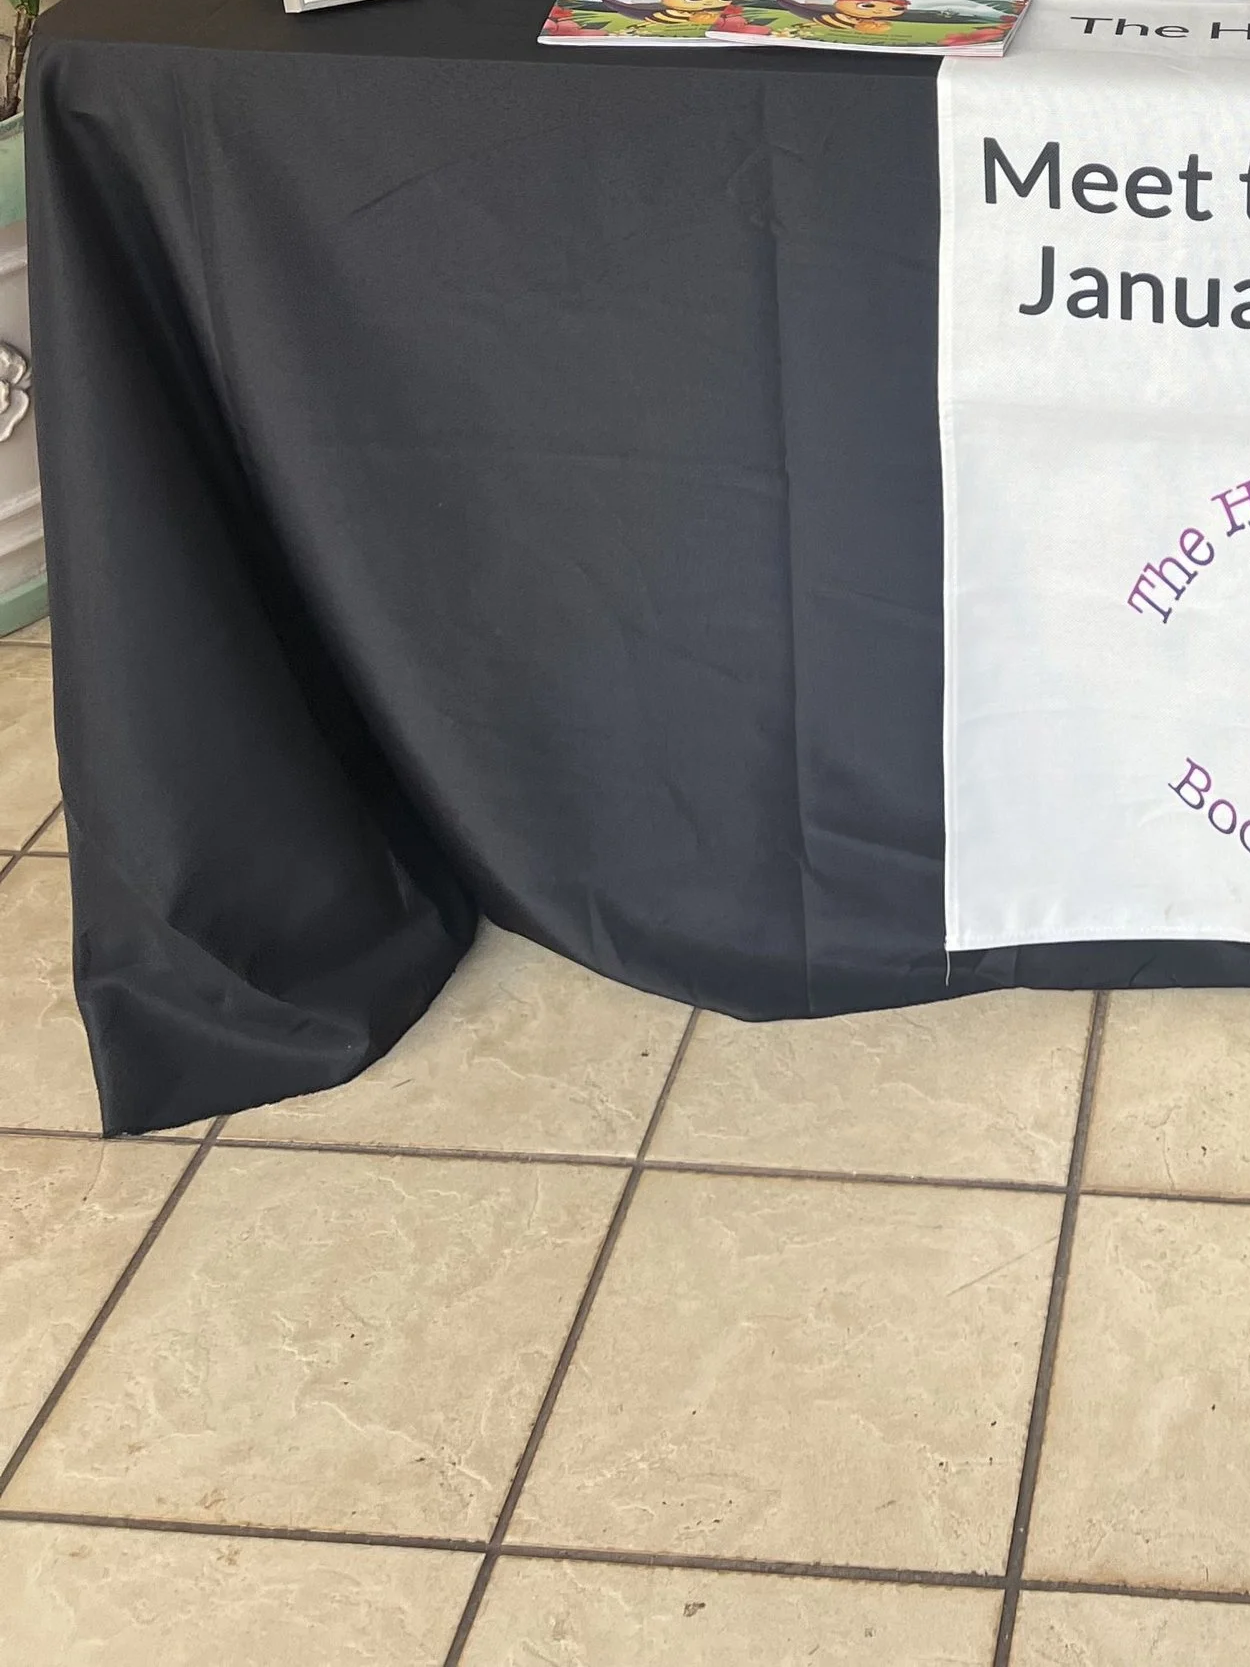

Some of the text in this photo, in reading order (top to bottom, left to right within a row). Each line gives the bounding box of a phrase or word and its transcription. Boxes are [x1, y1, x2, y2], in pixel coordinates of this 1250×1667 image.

[1069, 15, 1190, 41] The
[983, 136, 1215, 222] Meet
[1127, 527, 1215, 624] The
